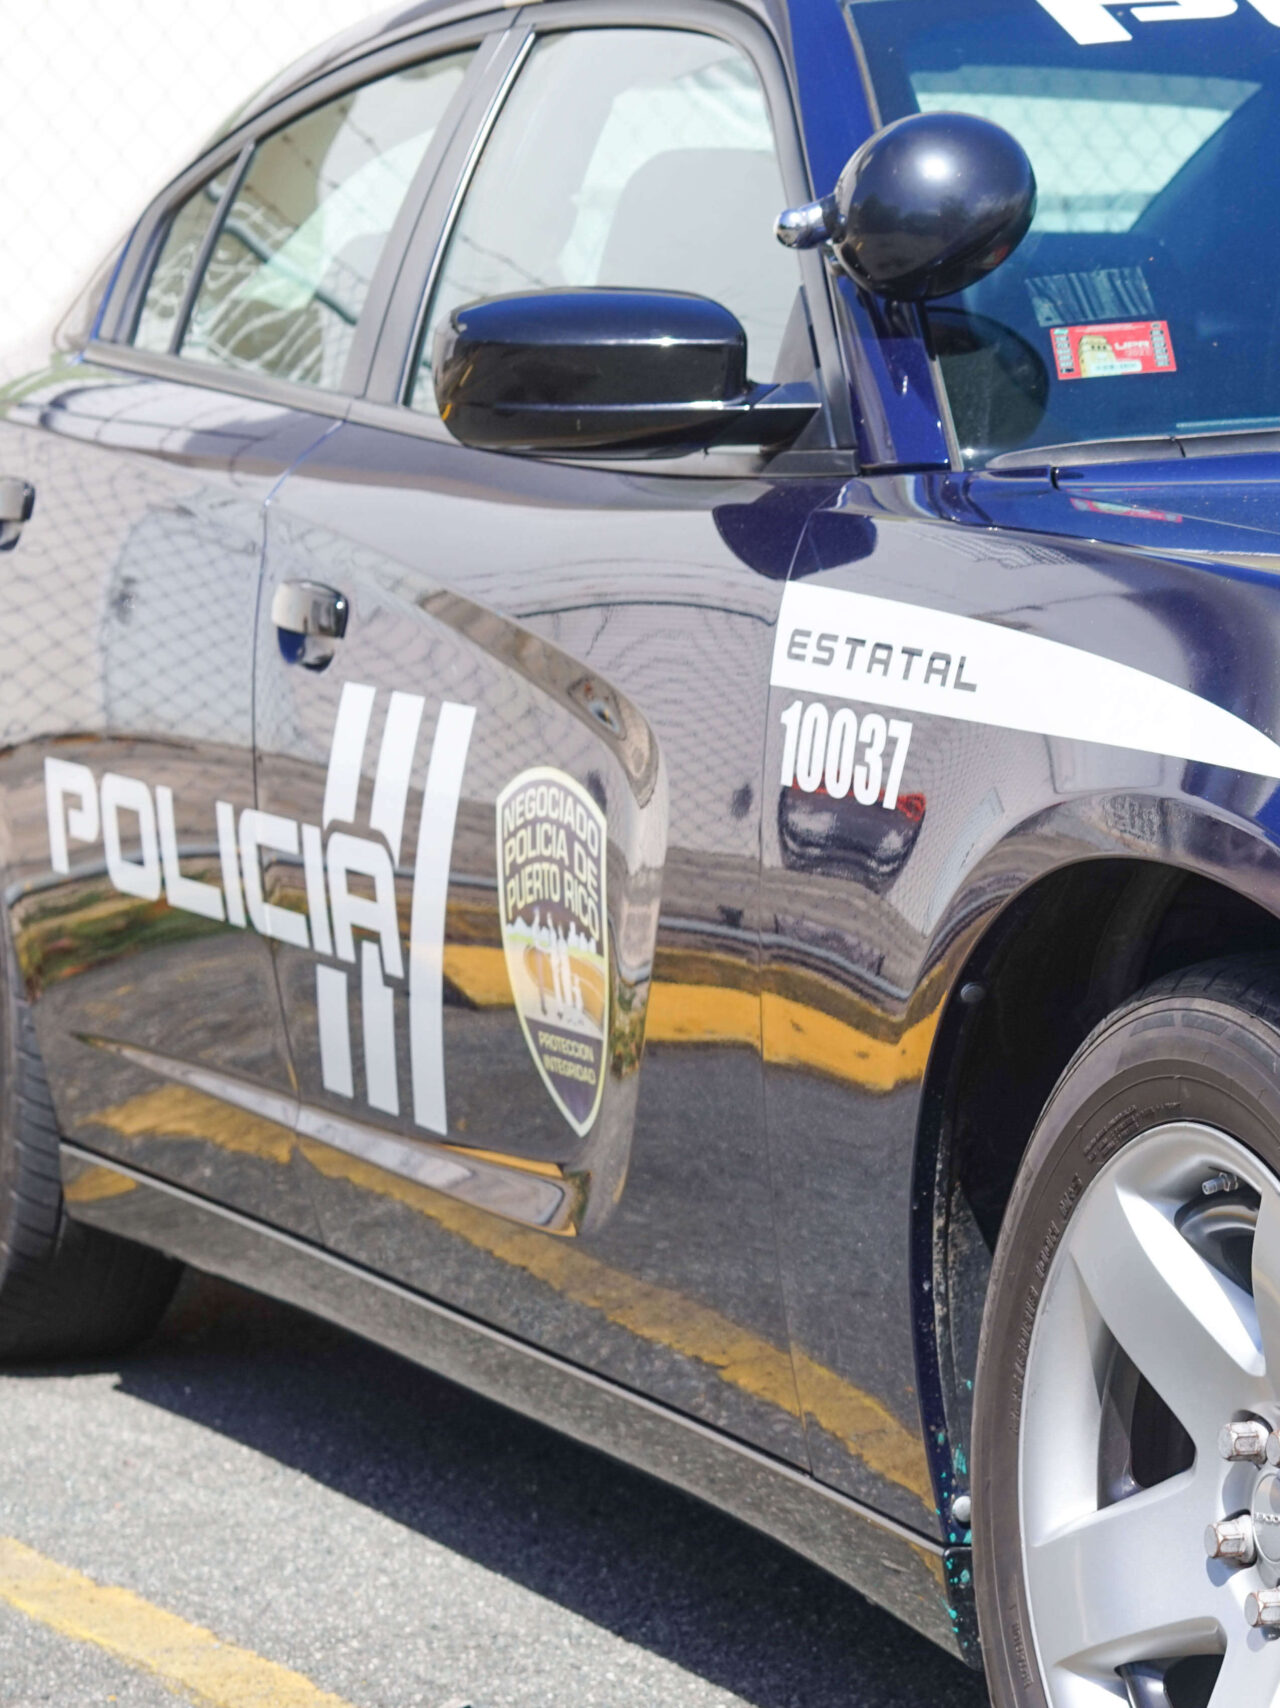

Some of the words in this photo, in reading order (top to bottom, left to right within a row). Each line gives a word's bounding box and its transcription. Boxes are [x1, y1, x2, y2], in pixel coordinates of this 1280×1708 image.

[786, 628, 978, 692] ESTATAL
[780, 700, 913, 810] 10037
[503, 785, 599, 859] NEGOCIADO
[504, 821, 570, 877] POLICIA
[573, 840, 598, 902] DE
[44, 756, 404, 979] POLICIA
[506, 861, 561, 921] PUERTO
[563, 869, 600, 942] RICO
